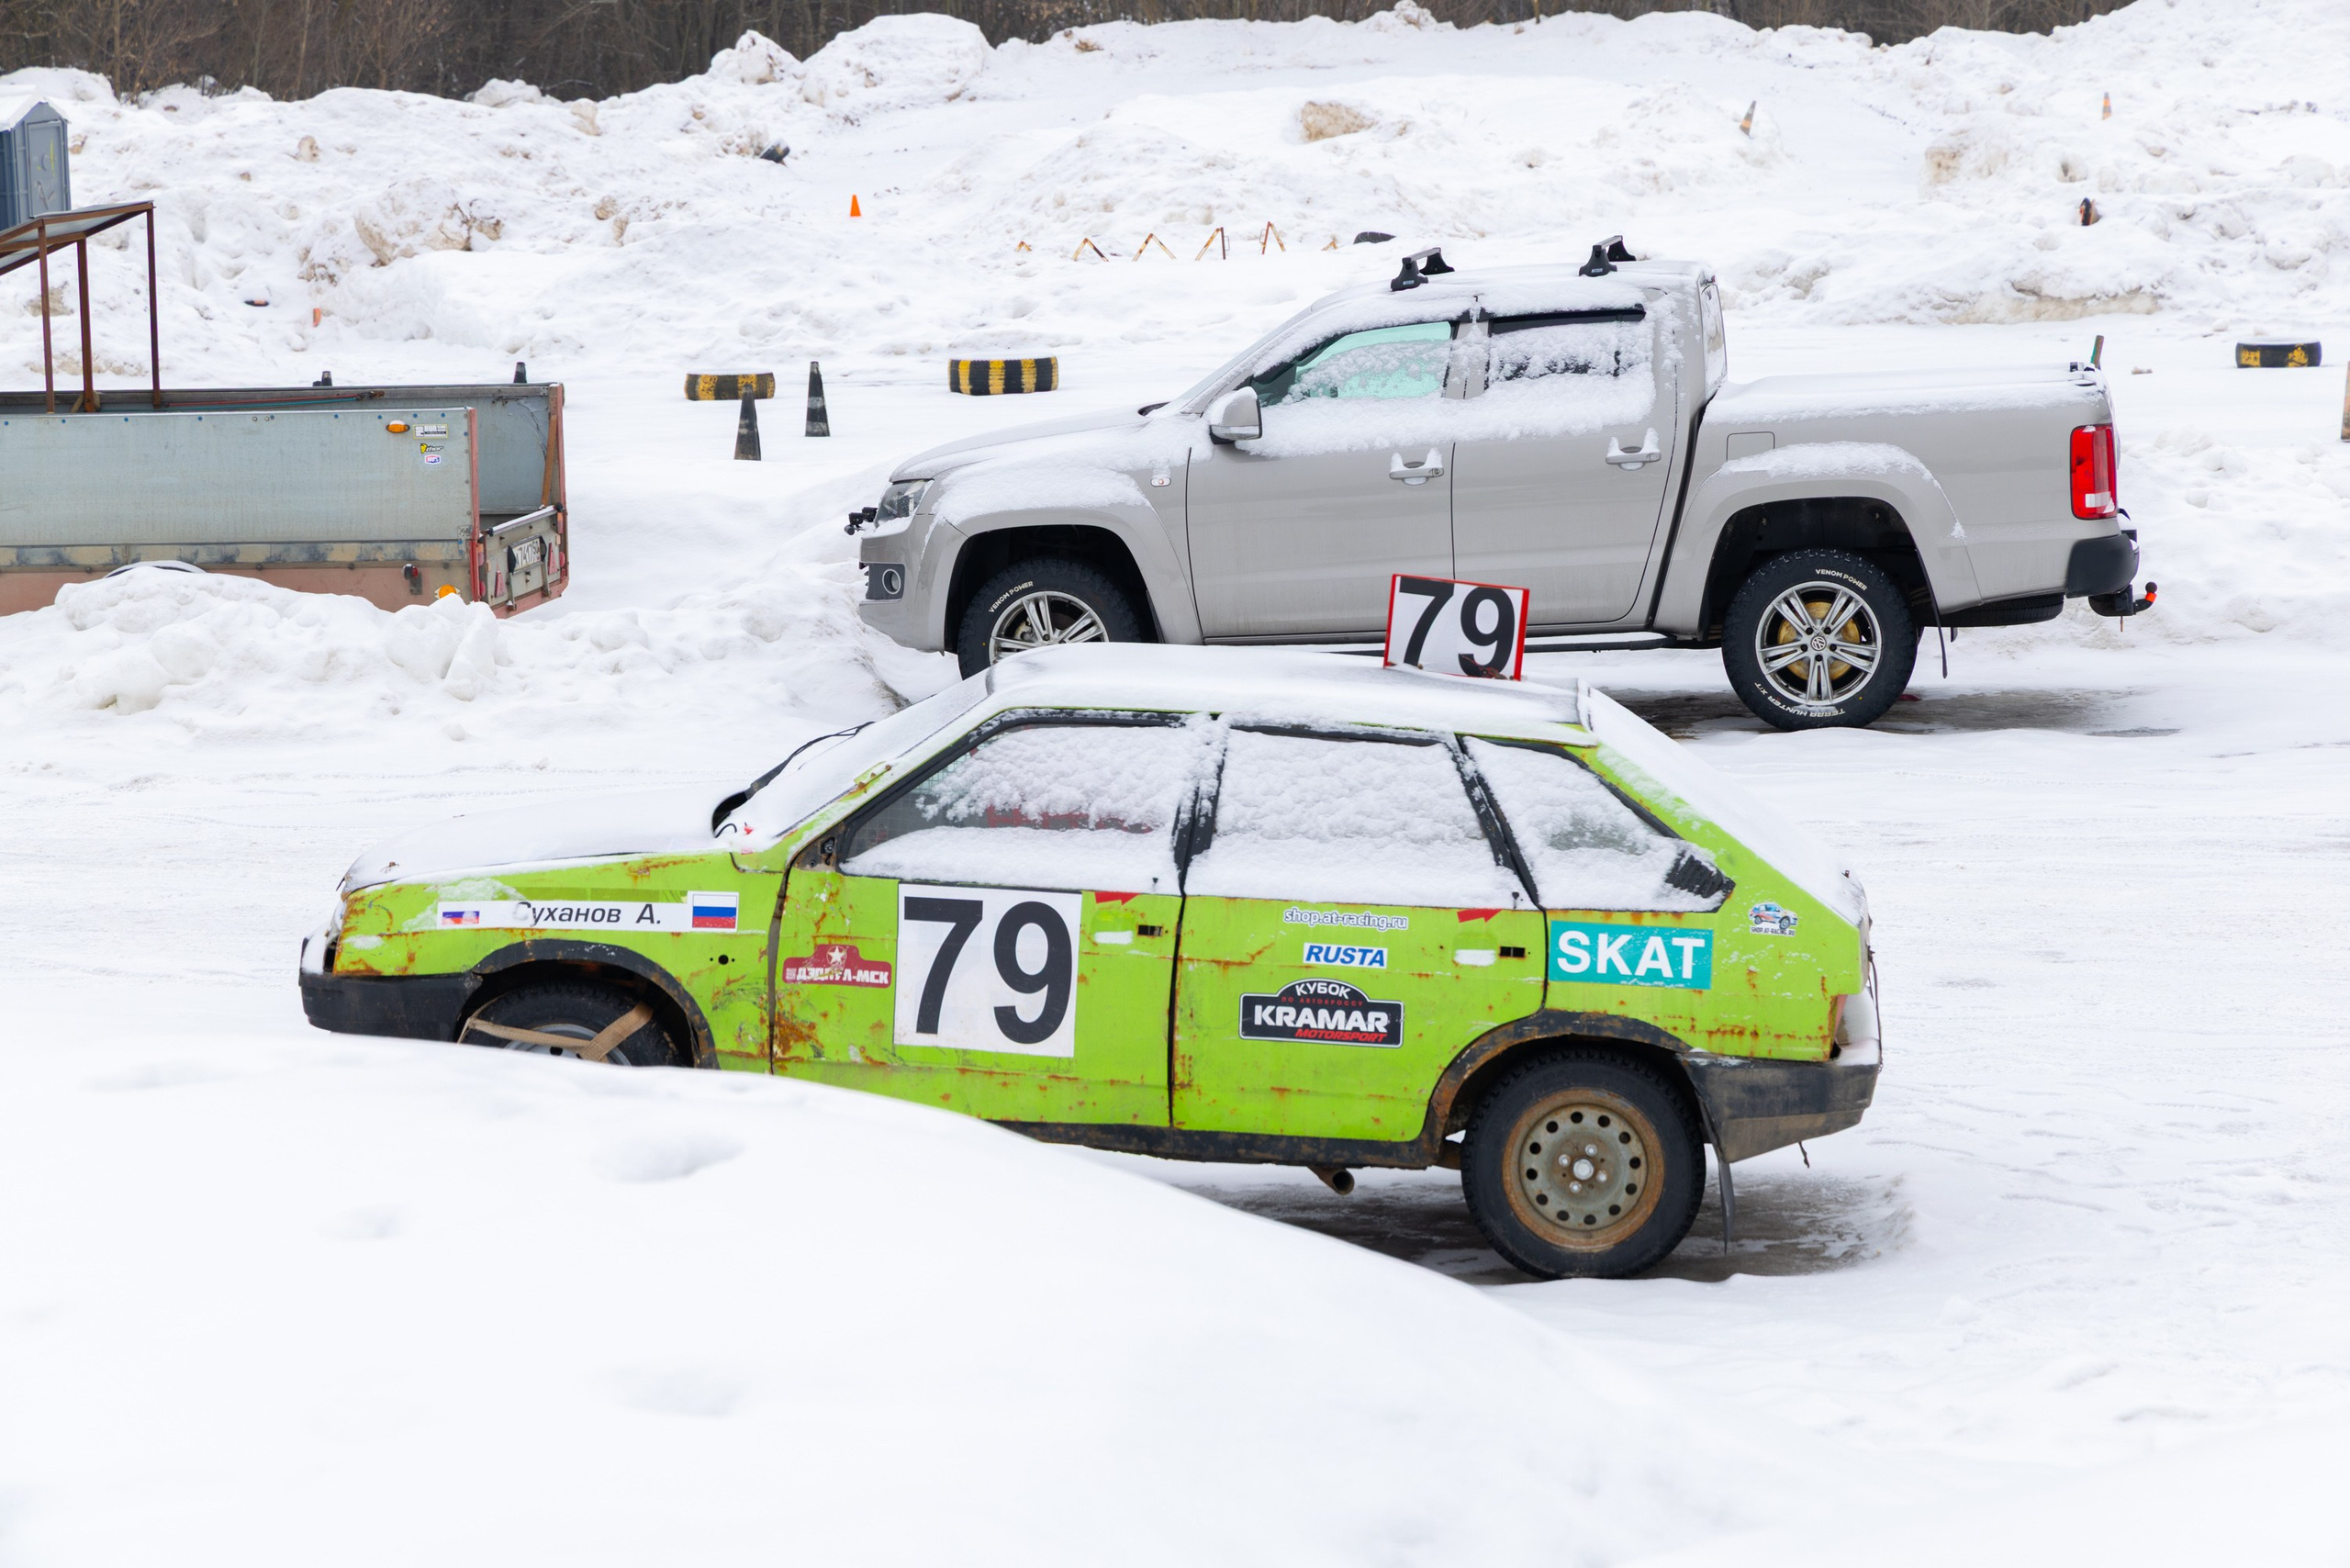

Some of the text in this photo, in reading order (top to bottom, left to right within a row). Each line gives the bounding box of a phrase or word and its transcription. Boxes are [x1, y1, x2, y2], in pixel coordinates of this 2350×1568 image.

[1815, 568, 1868, 591] VENOM POWER
[989, 580, 1034, 612] VENOM POWER
[1399, 576, 1515, 677] 79
[1767, 695, 1807, 716] HUNTER
[1809, 708, 1846, 718] TERRA
[636, 903, 661, 924] А.
[1283, 907, 1408, 932] shop.at-racing.ru
[1305, 945, 1385, 967] RUSTA
[1557, 930, 1706, 980] SKAT
[903, 895, 1072, 1045] 79
[1295, 982, 1352, 1000] КУБОК
[1299, 997, 1363, 1007] АВТОКРОССУ
[1254, 1004, 1389, 1033] KRAMAR
[1294, 1028, 1388, 1043] MOTORSPORT
